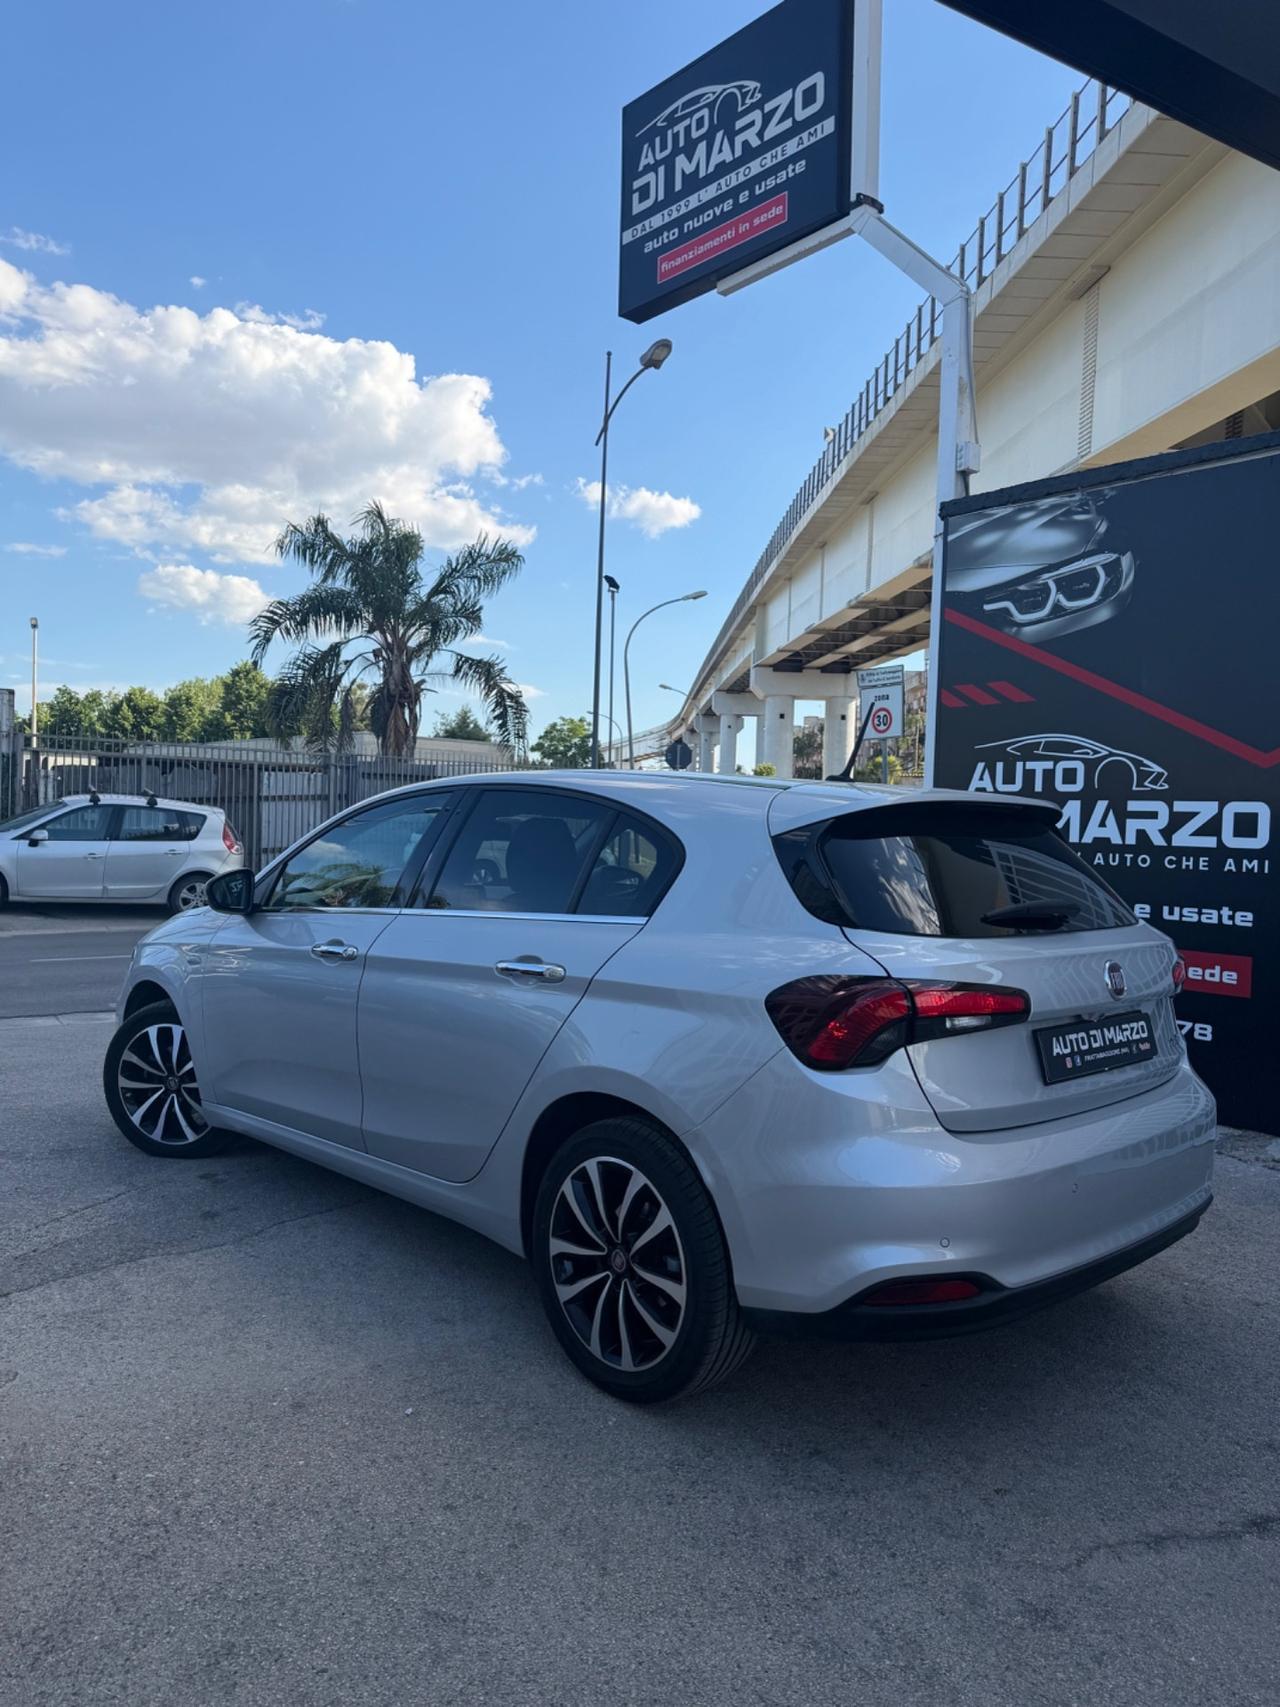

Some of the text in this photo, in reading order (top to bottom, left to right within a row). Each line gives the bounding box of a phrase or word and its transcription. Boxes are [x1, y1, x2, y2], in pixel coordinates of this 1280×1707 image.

[631, 71, 825, 216] DI MARZO
[638, 107, 710, 172] AUTO
[631, 220, 654, 239] DAL
[661, 199, 691, 222] 1999
[715, 166, 752, 194] AUTO
[760, 144, 788, 168] CHE
[796, 127, 825, 149] AMI
[643, 158, 807, 254] auto nuove e usate
[660, 204, 784, 274] finanziamenti in sede
[876, 714, 889, 727] 30
[968, 760, 1085, 793] AUTO
[1093, 852, 1269, 874] AUTO CHE AMI
[1133, 903, 1254, 927] e usate
[1187, 965, 1238, 985] ede
[1052, 1031, 1089, 1057] AUTO
[1090, 1029, 1103, 1046] DI
[1104, 1020, 1149, 1046] MARZO
